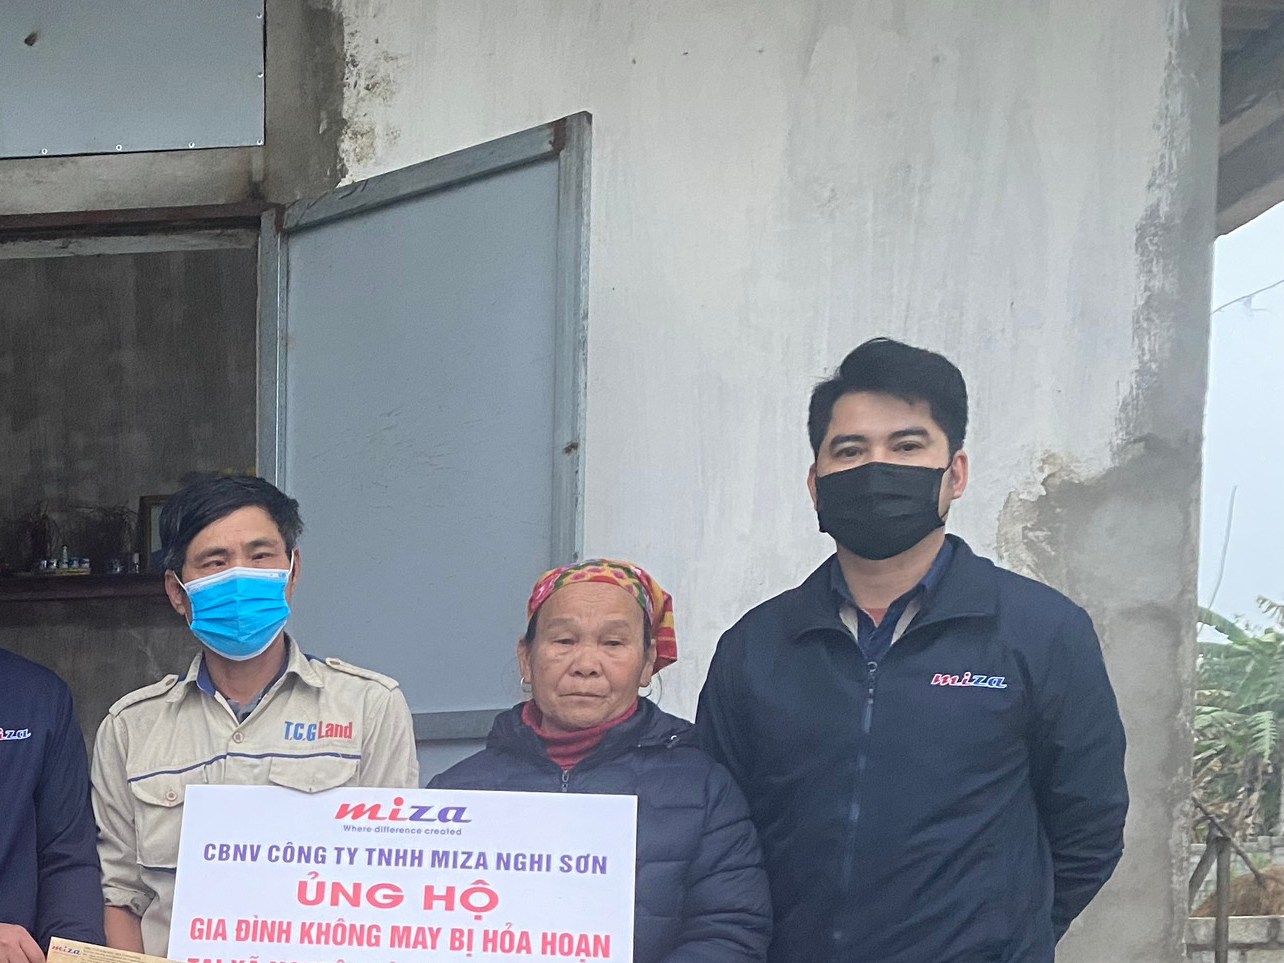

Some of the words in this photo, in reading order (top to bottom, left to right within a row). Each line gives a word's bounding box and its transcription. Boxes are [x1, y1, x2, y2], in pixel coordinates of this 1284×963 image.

[930, 671, 1007, 688] miza
[317, 720, 353, 741] Land
[335, 796, 472, 823] miza
[343, 825, 372, 833] Where
[374, 825, 422, 835] difference
[424, 828, 462, 836] created
[203, 843, 261, 862] CBNV
[267, 841, 327, 864] CÔNG
[334, 847, 358, 866] TY
[365, 848, 424, 867] TNHH
[430, 850, 489, 870] MIZA
[496, 852, 552, 872] NGHI
[559, 853, 607, 875] SƠN
[297, 871, 405, 909] ỦNG
[423, 879, 500, 920] HỘ
[190, 917, 227, 941] GIA
[235, 914, 292, 943] ĐÌNH
[299, 918, 381, 948] KHÔNG
[389, 925, 442, 950] MAY
[449, 927, 474, 957] BỊ
[482, 922, 532, 955] HỎA
[541, 932, 611, 963] HOẠN
